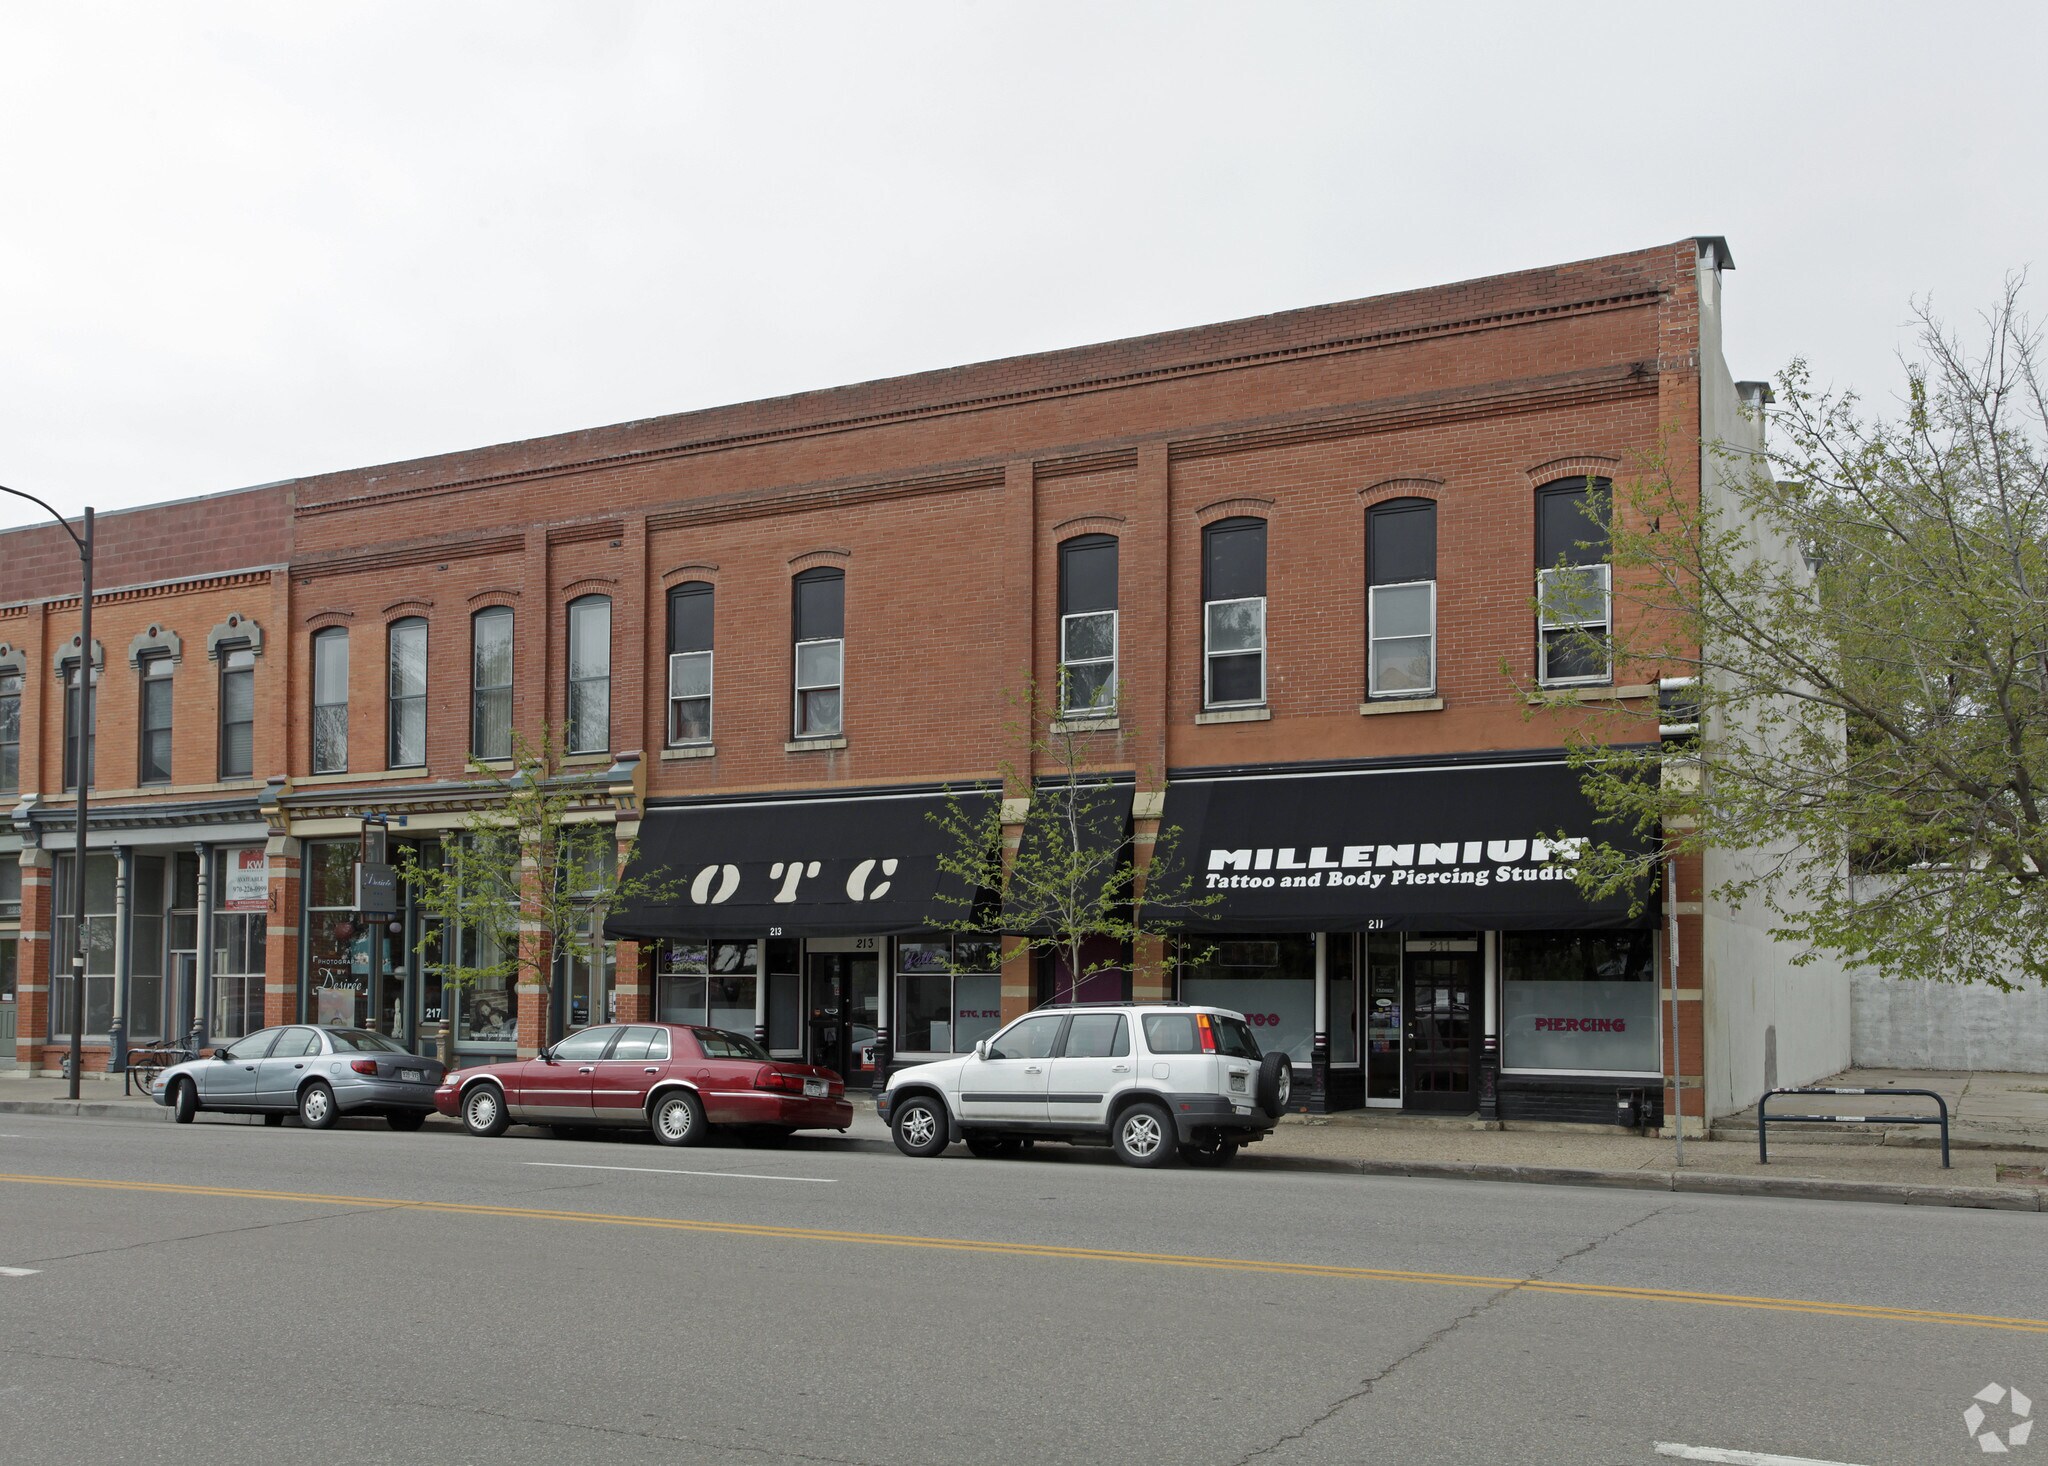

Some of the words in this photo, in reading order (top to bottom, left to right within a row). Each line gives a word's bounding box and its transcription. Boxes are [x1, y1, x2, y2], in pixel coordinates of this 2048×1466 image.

[1207, 837, 1582, 871] MILLENNIUM
[247, 860, 264, 869] KW
[1205, 873, 1276, 889] Tattoo
[1280, 872, 1322, 888] and
[1327, 871, 1386, 889] Body
[1391, 868, 1490, 887] Piercing
[1496, 865, 1578, 882] Studio
[1368, 919, 1384, 929] 211
[770, 927, 782, 936] 213
[856, 938, 874, 949] 213
[1429, 940, 1451, 952] 211
[316, 967, 362, 991] Desirée
[426, 1008, 442, 1018] 217
[1244, 1013, 1280, 1027] TOO
[1535, 1017, 1626, 1033] PIERCING
